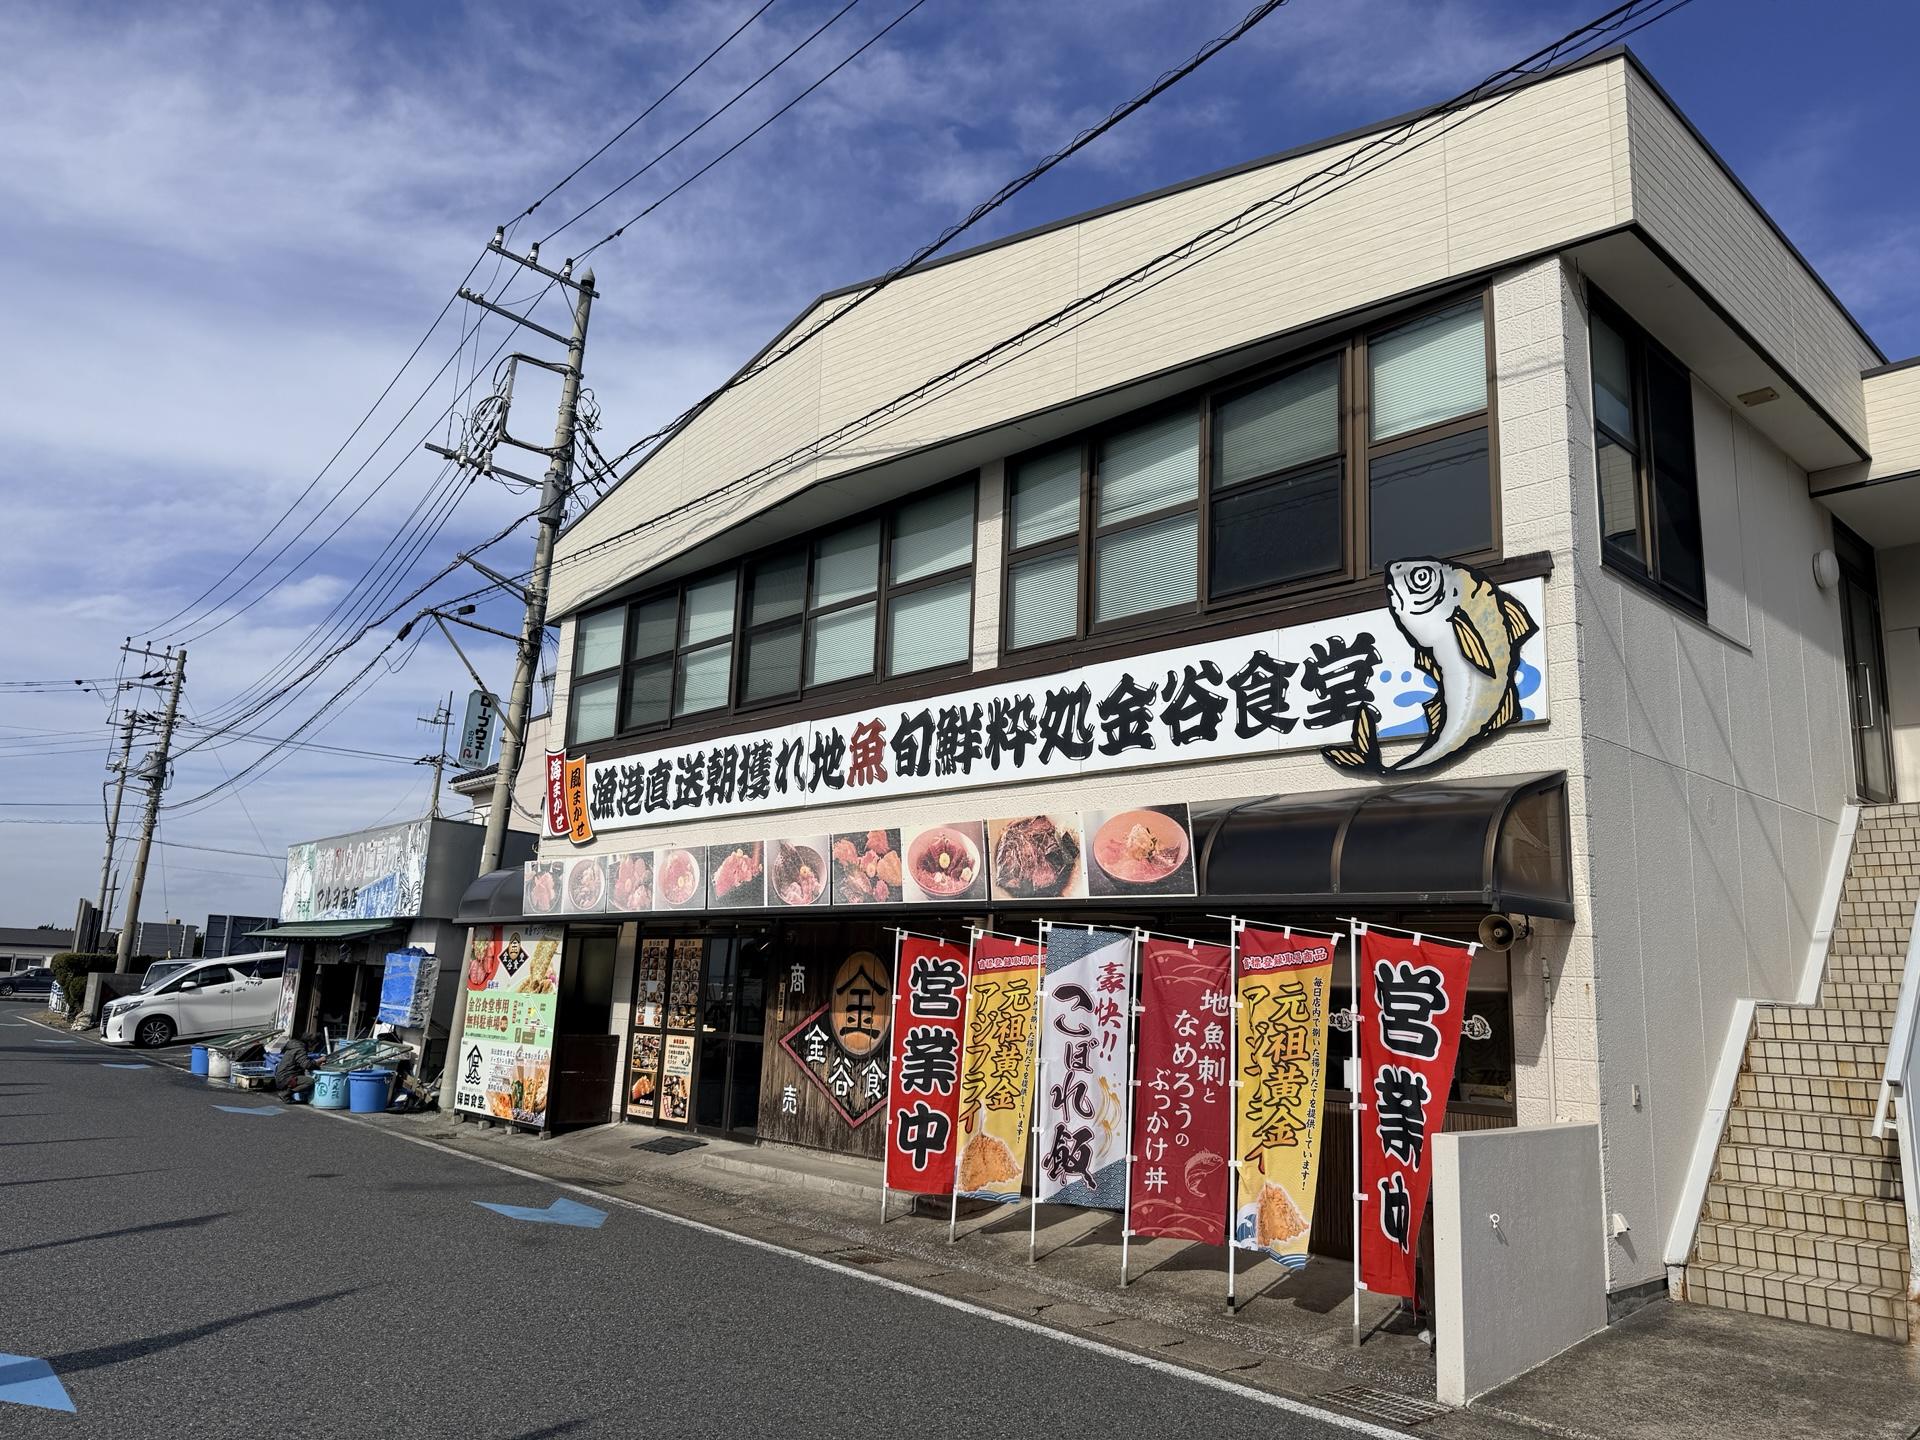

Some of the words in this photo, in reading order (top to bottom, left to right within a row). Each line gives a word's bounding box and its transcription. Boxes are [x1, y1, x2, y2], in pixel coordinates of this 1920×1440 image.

[550, 758, 565, 830] 海まかせ
[570, 767, 585, 836] 風まかせ
[467, 996, 510, 1014] 金谷食堂専用
[900, 955, 966, 1171] 営業中
[959, 981, 999, 1134] アジフライ
[986, 978, 1031, 1111] 元祖黄金
[1094, 961, 1126, 1061] 豪快!!
[1197, 989, 1229, 1104] 地魚刺と
[1262, 981, 1311, 1149] 元祖黄金
[1042, 982, 1099, 1190] こぼれ飯
[1144, 1067, 1171, 1194] ぶっかけ丼
[1172, 1009, 1198, 1148] なめろうの
[1374, 959, 1449, 1254] 営業中
